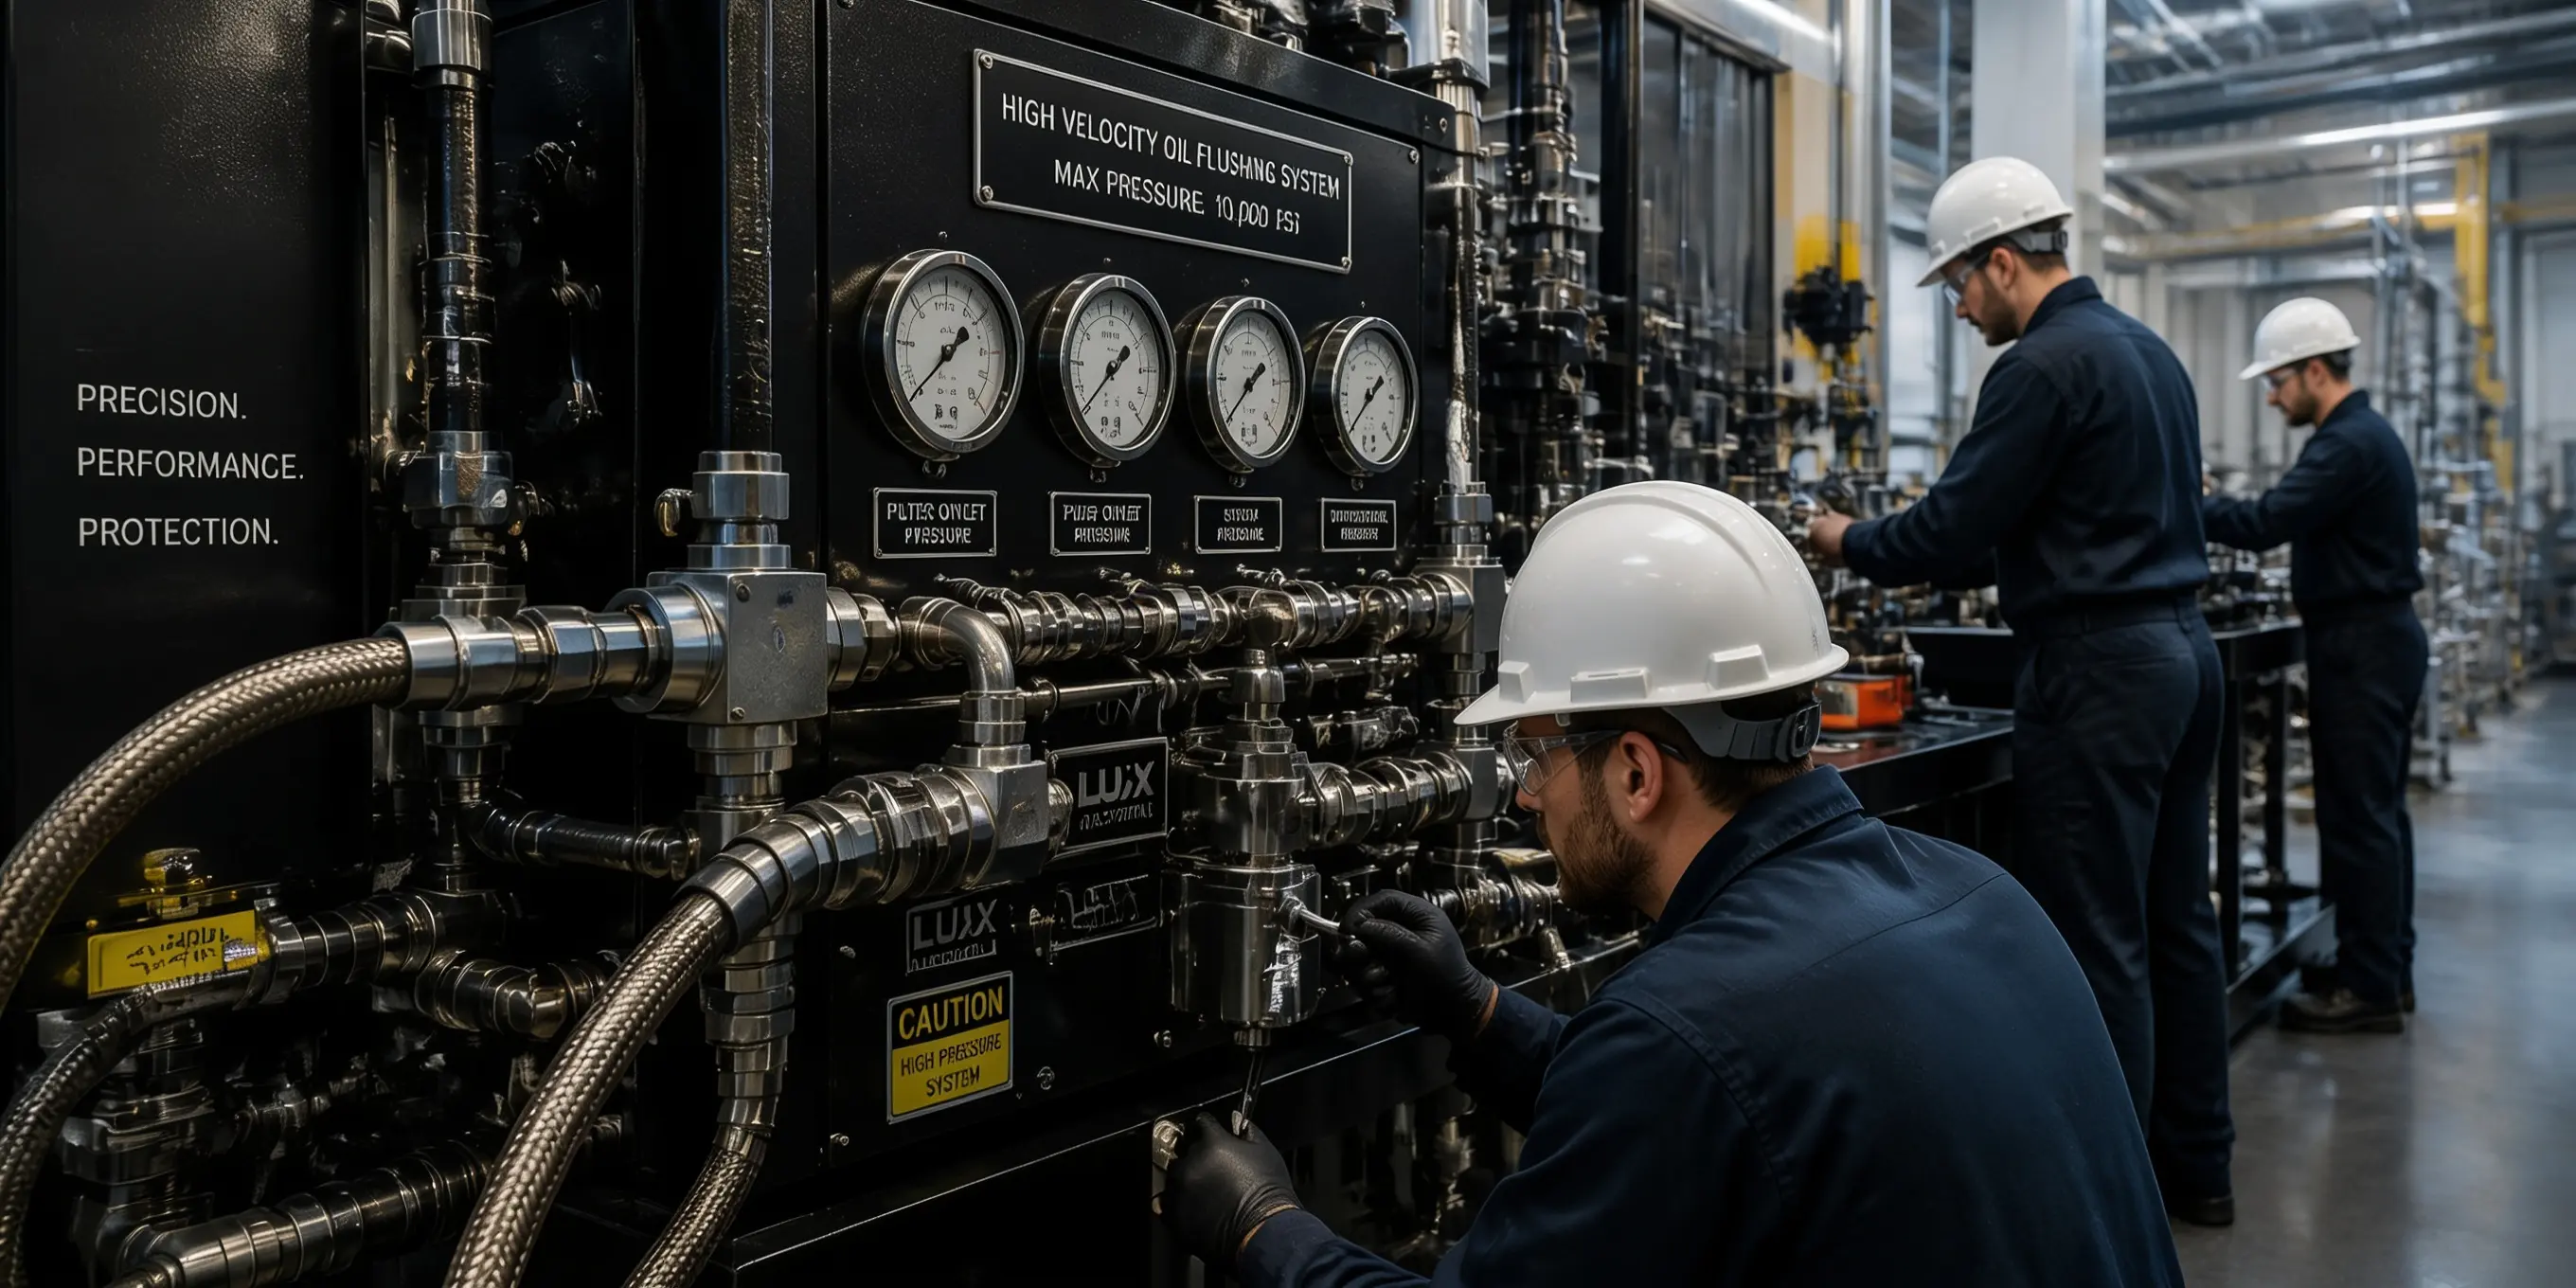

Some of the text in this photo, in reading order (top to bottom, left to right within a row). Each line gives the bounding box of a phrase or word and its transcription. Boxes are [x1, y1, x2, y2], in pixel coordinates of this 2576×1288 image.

[1002, 92, 1055, 131] HIGH
[1062, 106, 1159, 156] VELOCITY
[1163, 134, 1192, 166] OIL
[1281, 163, 1340, 201] SYSTEM
[1054, 159, 1100, 192] MAX
[1106, 170, 1205, 215] PRESSURE
[78, 384, 247, 420] PRECISION.
[78, 447, 304, 480] PERFORMANCE.
[79, 517, 278, 546] PROTECTION.
[898, 985, 1003, 1040] CAUTION
[901, 1051, 935, 1077] HIGH
[925, 1064, 980, 1097] SYSTEM
